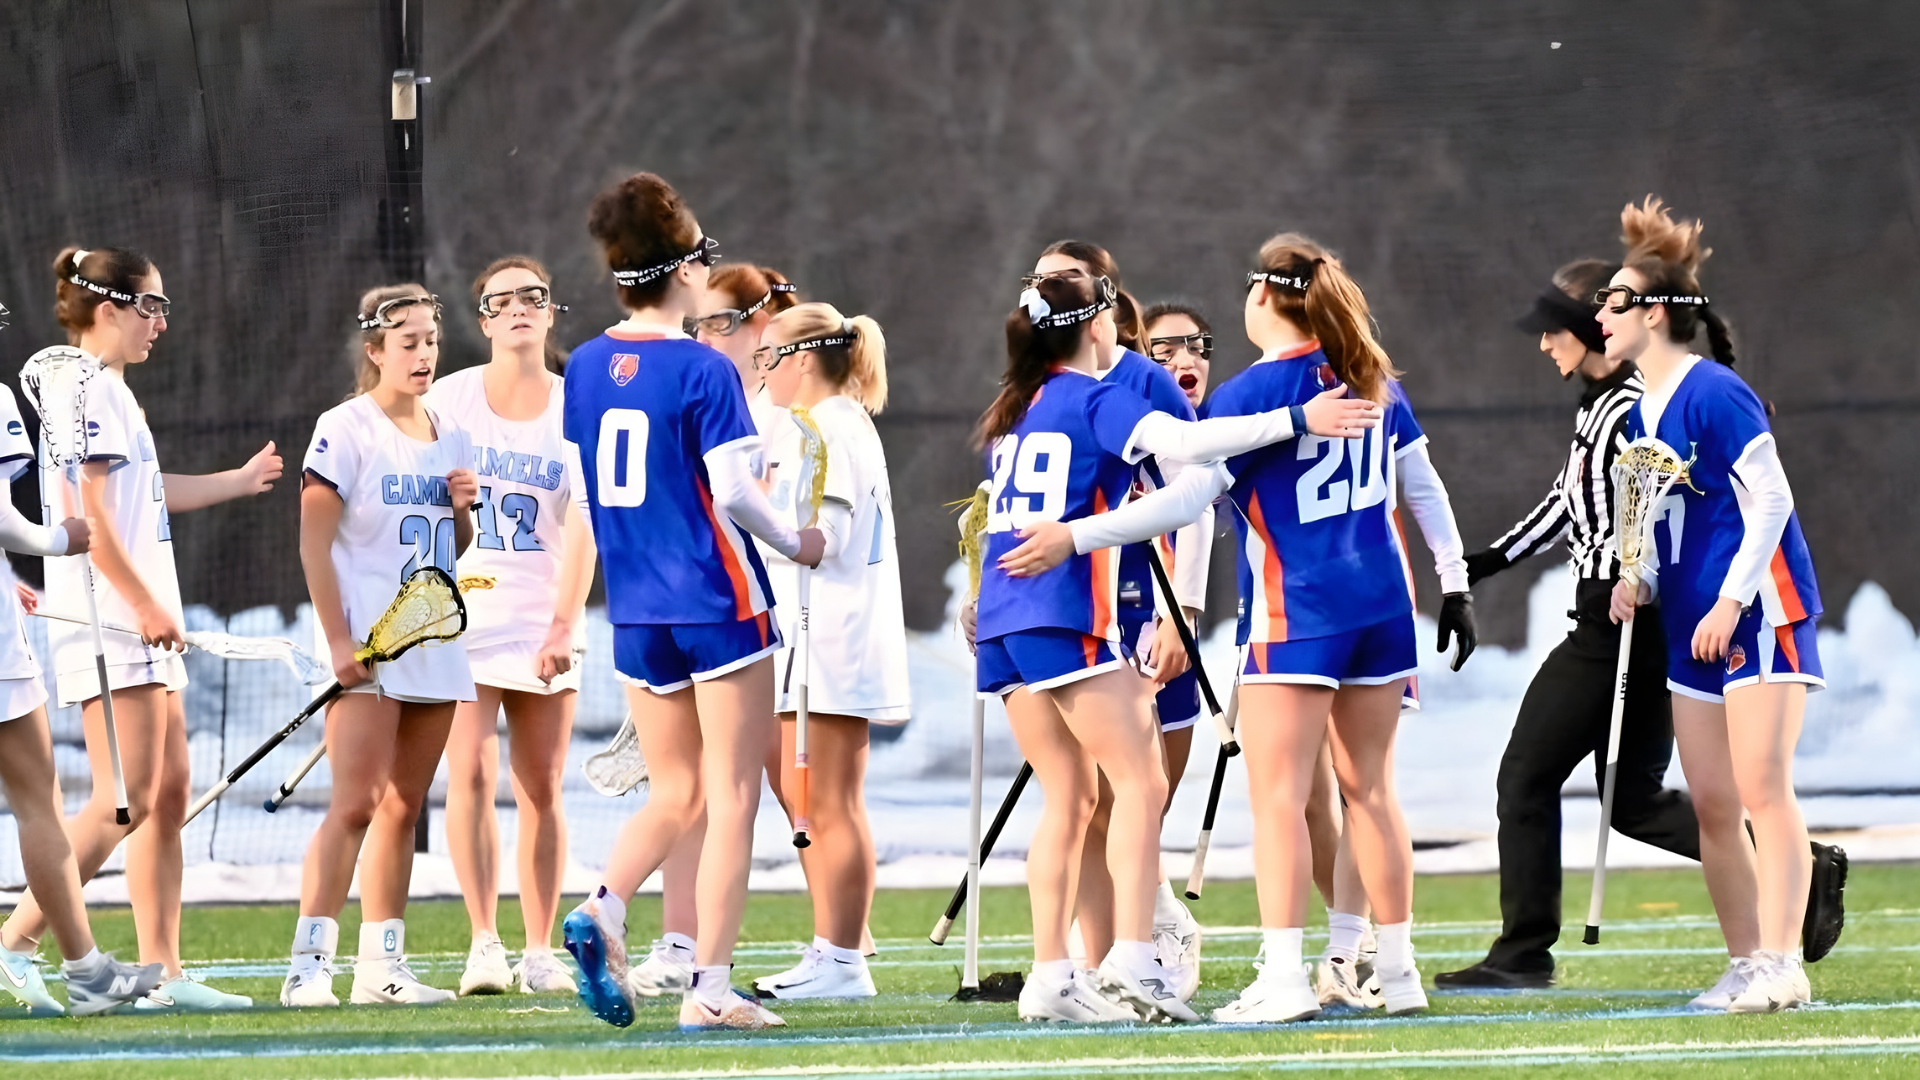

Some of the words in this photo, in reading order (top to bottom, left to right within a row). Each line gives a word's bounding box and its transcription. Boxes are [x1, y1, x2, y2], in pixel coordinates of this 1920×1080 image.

[684, 249, 702, 262] GAIT
[110, 291, 132, 302] GAIT
[1054, 317, 1075, 326] GAIT
[1079, 308, 1096, 320] GAIT
[779, 345, 795, 355] AIT
[799, 340, 821, 350] GAIT
[473, 446, 564, 491] AMELS
[596, 408, 650, 508] 0
[1296, 405, 1387, 524] 20
[382, 474, 454, 507] CAME
[987, 432, 1072, 534] 29
[477, 486, 546, 551] 12
[400, 515, 457, 585] 20
